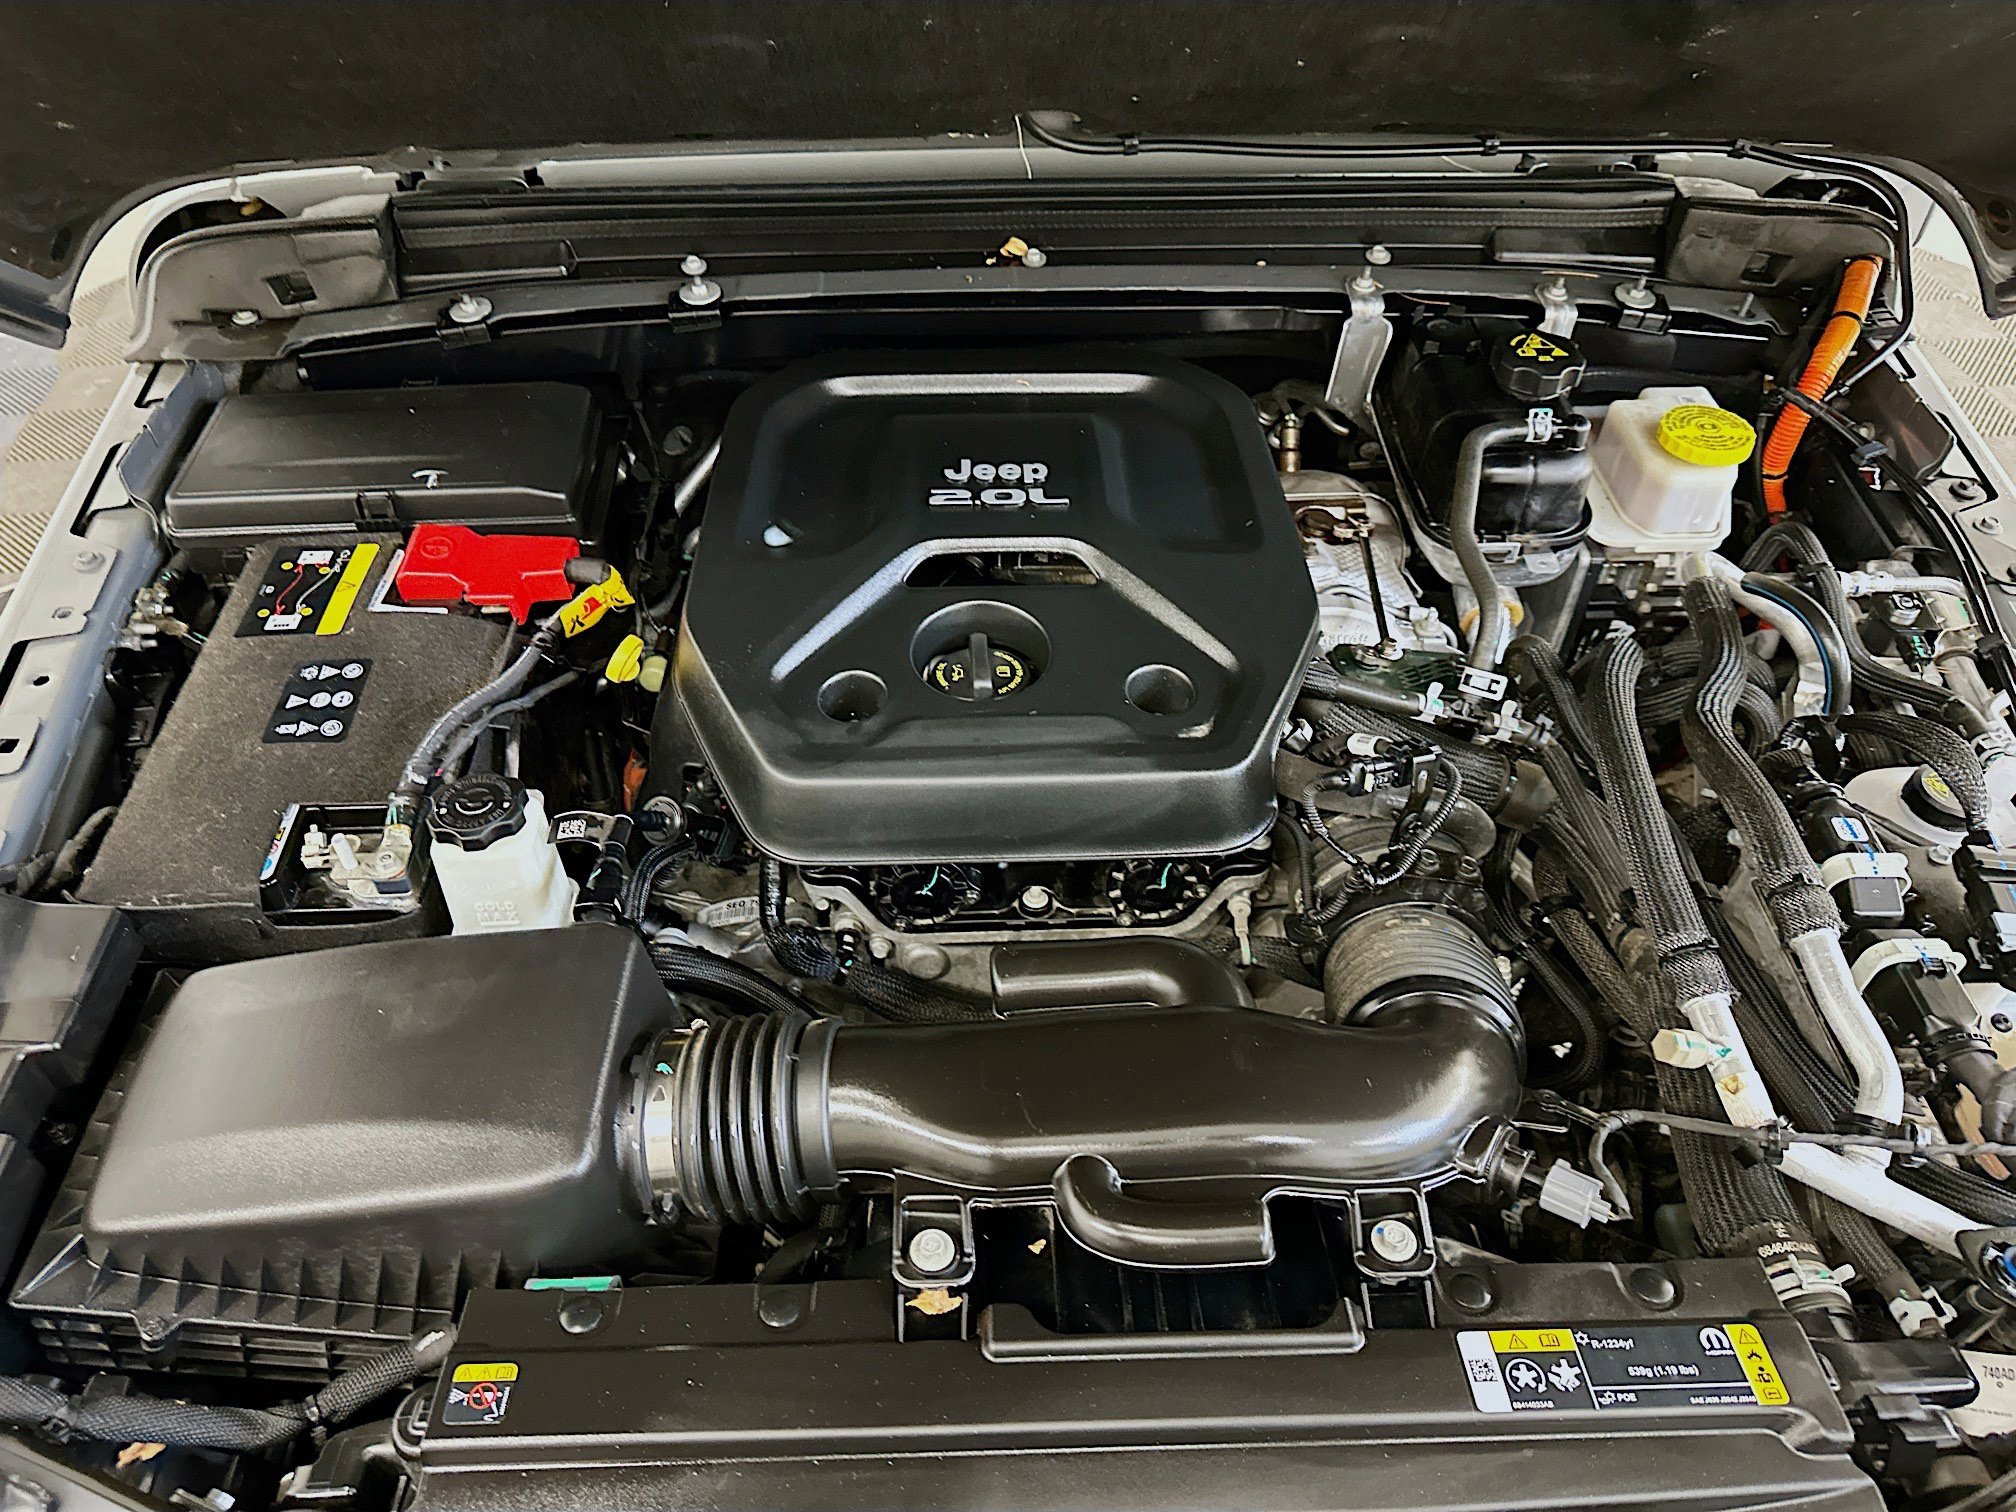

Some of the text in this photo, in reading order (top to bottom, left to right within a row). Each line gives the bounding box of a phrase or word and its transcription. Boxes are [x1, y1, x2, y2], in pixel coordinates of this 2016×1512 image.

[943, 458, 1049, 484] Jeep
[928, 487, 1071, 506] 2.0L
[474, 900, 515, 912] COLD
[476, 911, 518, 921] MAX
[1616, 1391, 1638, 1403] POE
